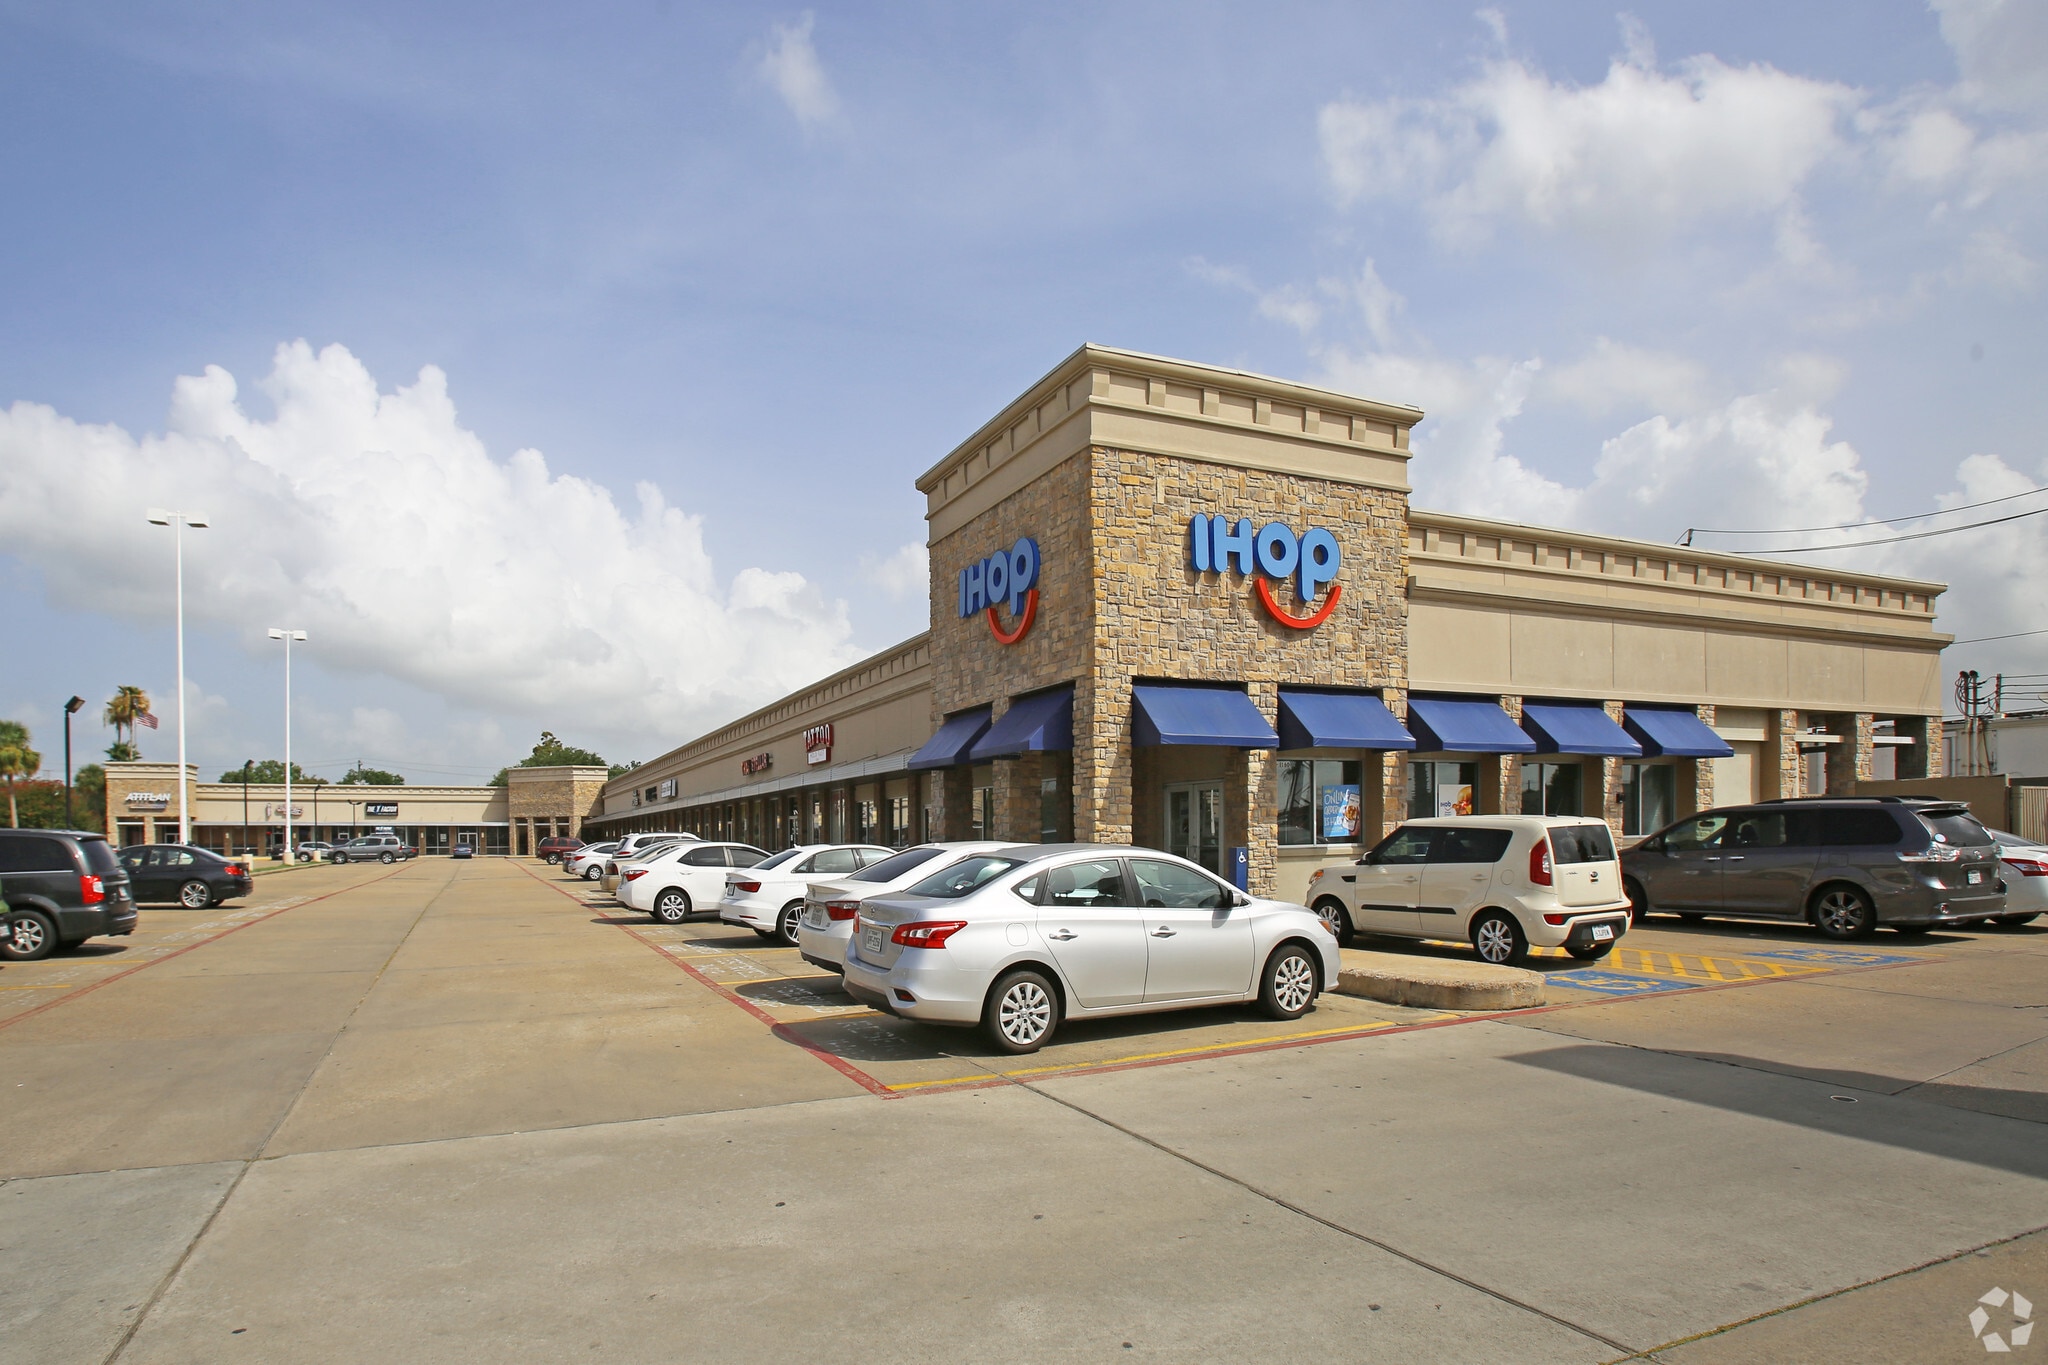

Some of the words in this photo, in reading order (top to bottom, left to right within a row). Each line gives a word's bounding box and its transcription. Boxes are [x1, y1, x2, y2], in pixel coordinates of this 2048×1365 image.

[958, 537, 1041, 619] IHOP
[1190, 513, 1341, 602] IHOP
[803, 723, 832, 752] TATTOO
